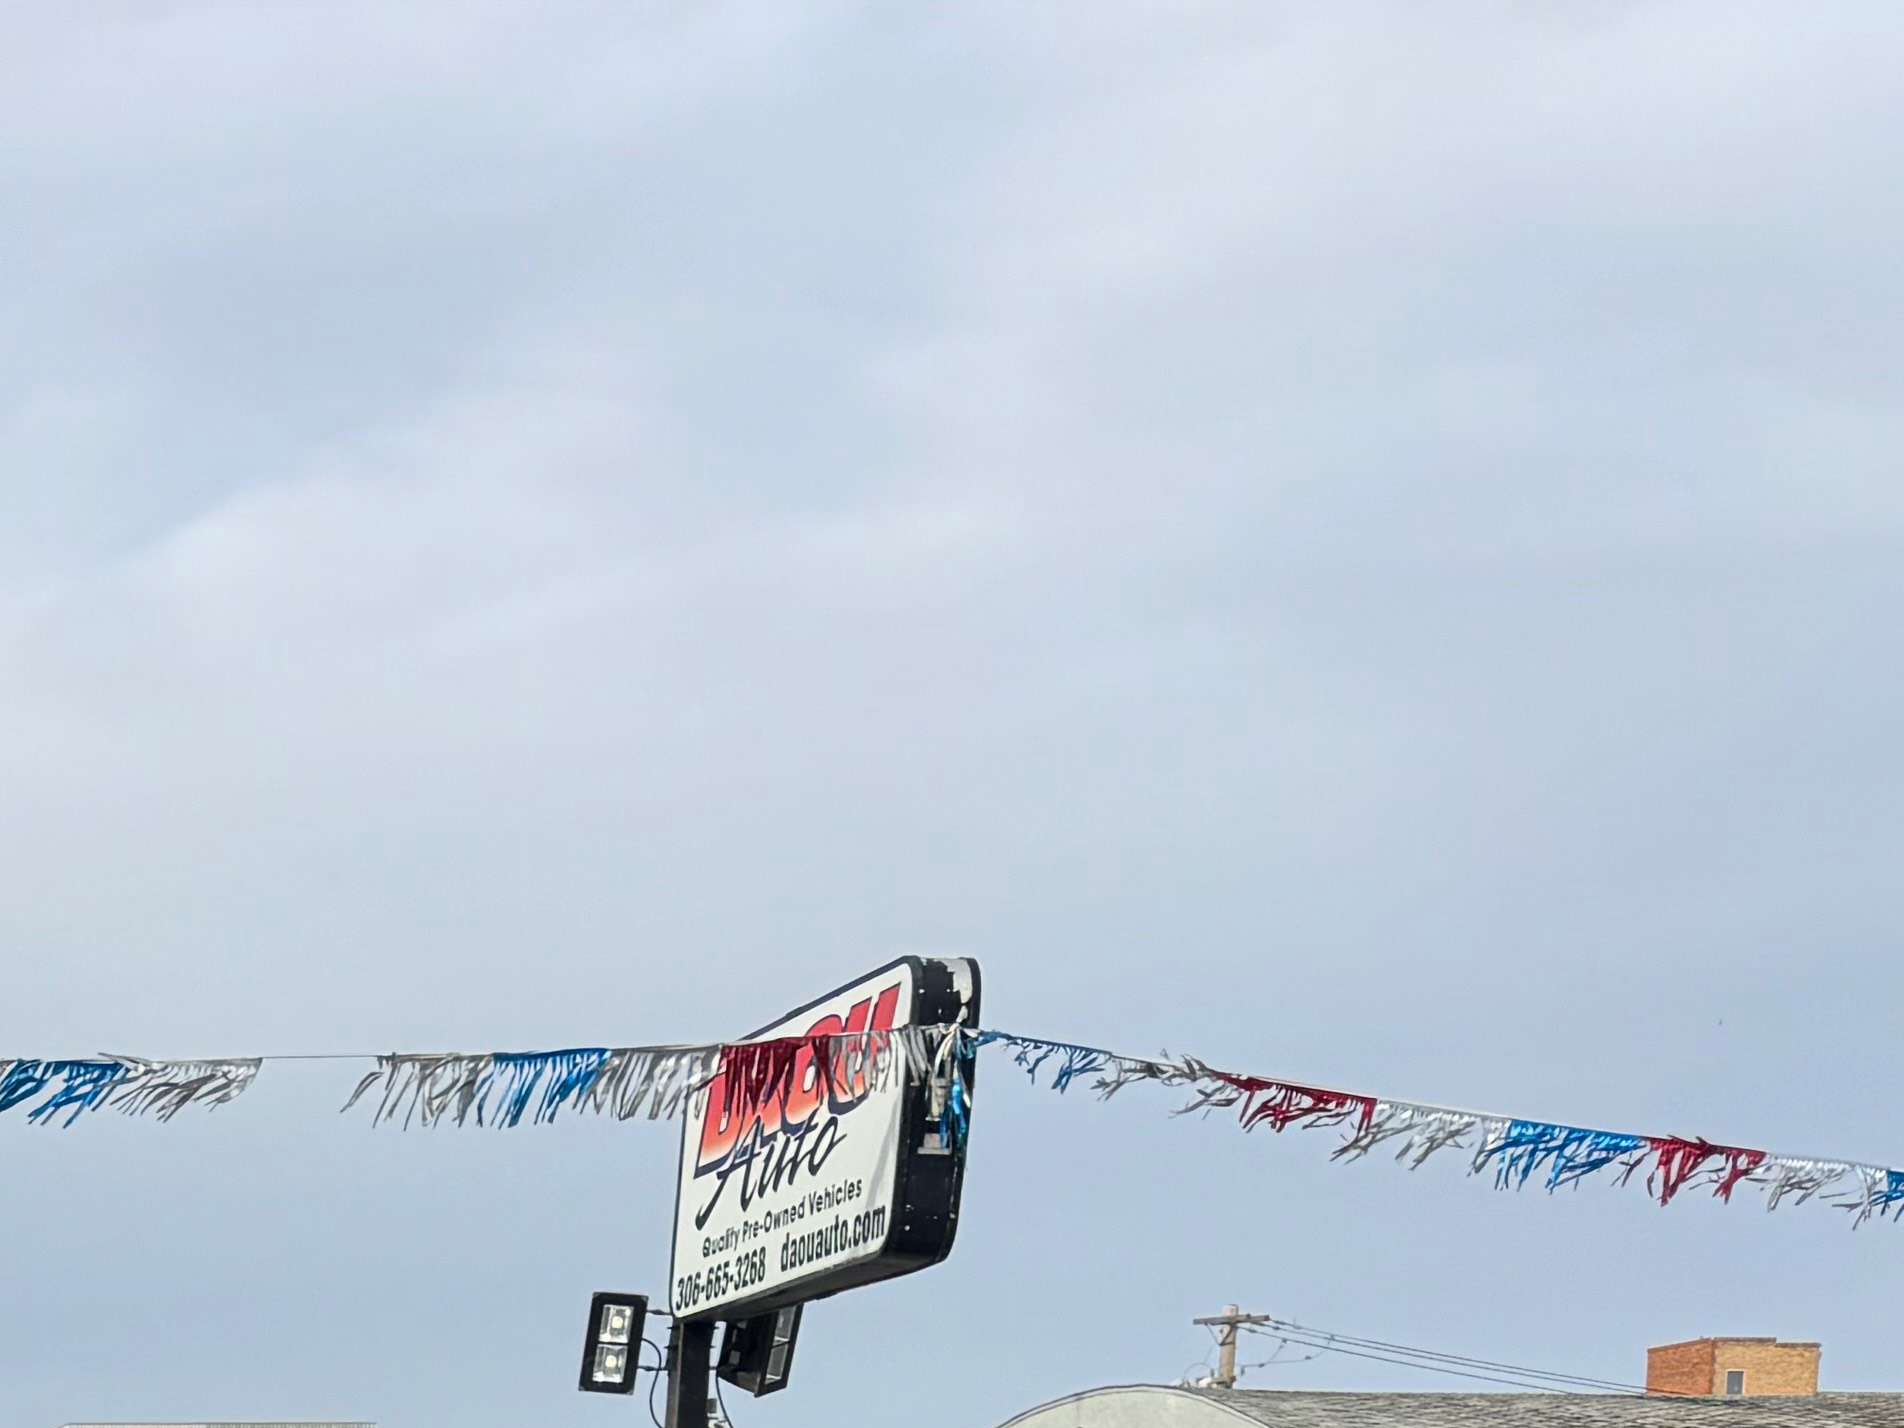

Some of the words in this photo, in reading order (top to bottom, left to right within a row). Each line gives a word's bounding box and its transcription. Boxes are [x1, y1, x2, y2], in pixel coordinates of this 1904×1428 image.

[695, 1115, 847, 1230] Auto
[702, 1226, 741, 1258] Quality
[742, 1196, 806, 1242] Pre-Owned
[808, 1178, 863, 1216] Vehicles
[676, 1246, 767, 1311] 306-665-3268
[780, 1204, 887, 1272] daouauto.com
